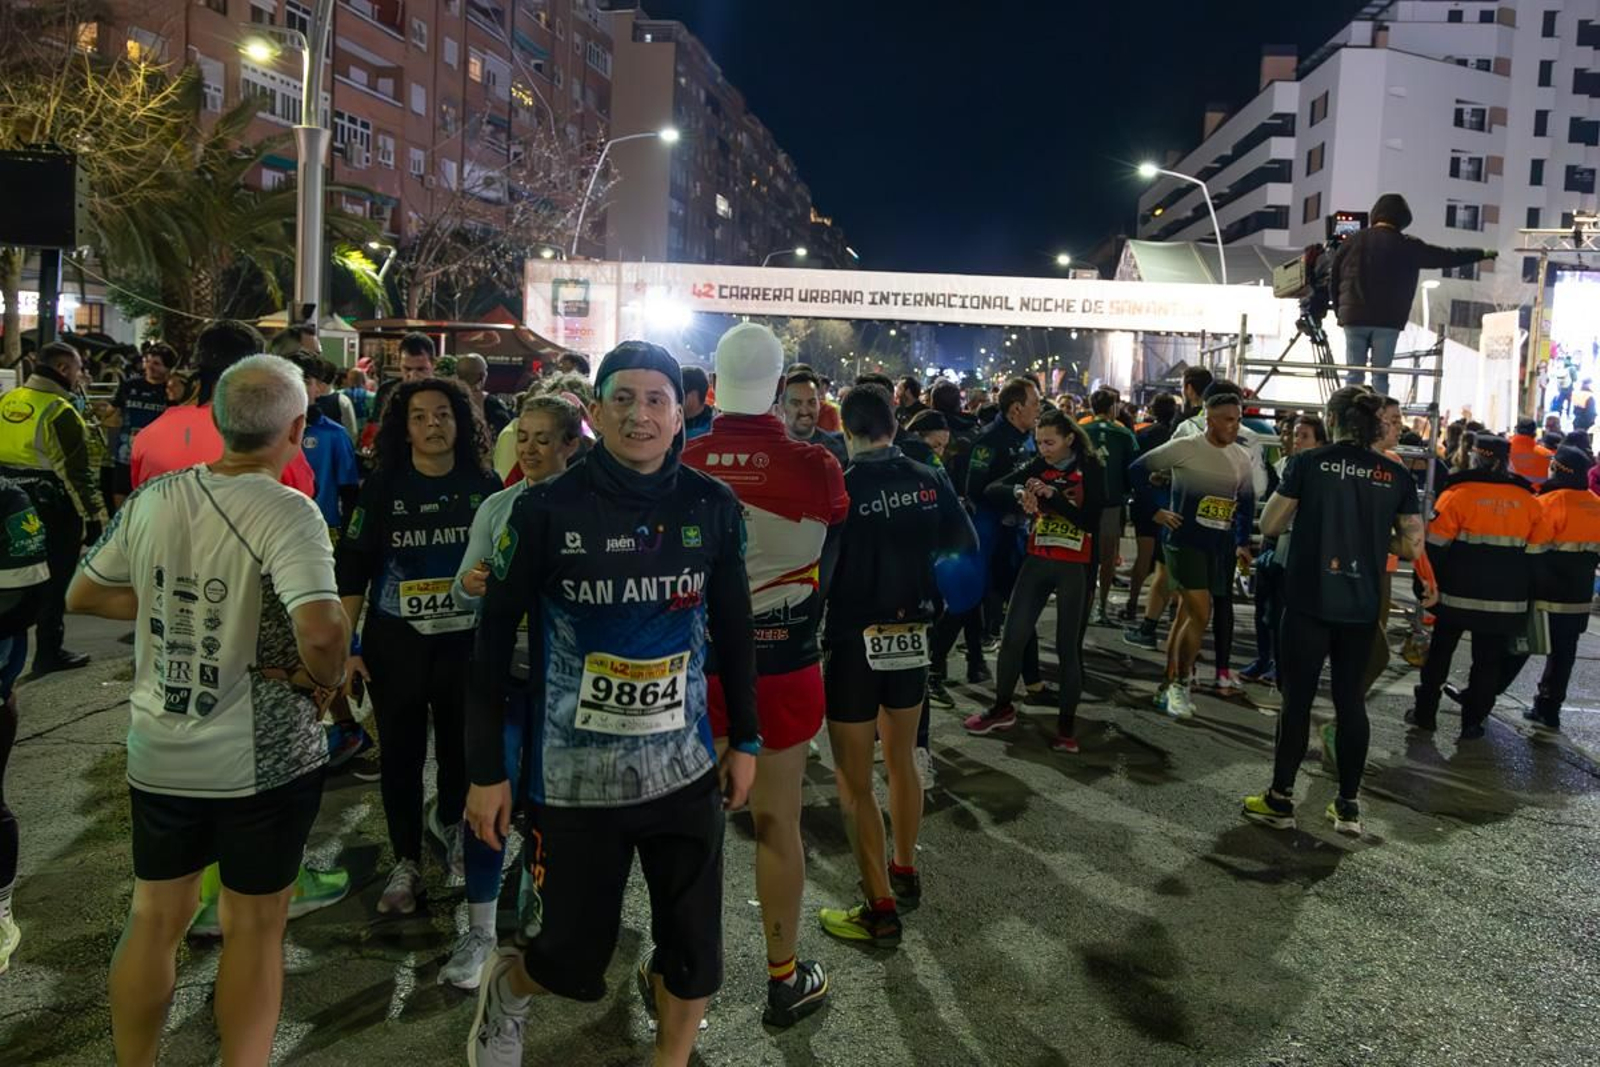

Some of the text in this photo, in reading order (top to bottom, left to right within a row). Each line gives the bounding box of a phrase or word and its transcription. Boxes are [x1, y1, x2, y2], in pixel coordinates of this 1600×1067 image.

[692, 283, 715, 299] 42
[718, 284, 794, 302] CARRERA
[798, 288, 864, 305] URBANA
[868, 291, 1014, 311] INTERNACIONAL
[1019, 296, 1076, 313] NOCHE
[1081, 299, 1105, 314] DE
[1320, 459, 1393, 482] calderón
[859, 481, 938, 518] calderón
[391, 526, 470, 548] SAN ANT
[1041, 522, 1078, 536] 3294
[561, 567, 705, 604] SAN ANTÓN
[407, 592, 455, 615] 944
[870, 632, 922, 653] 8768
[591, 675, 678, 707] 9864
